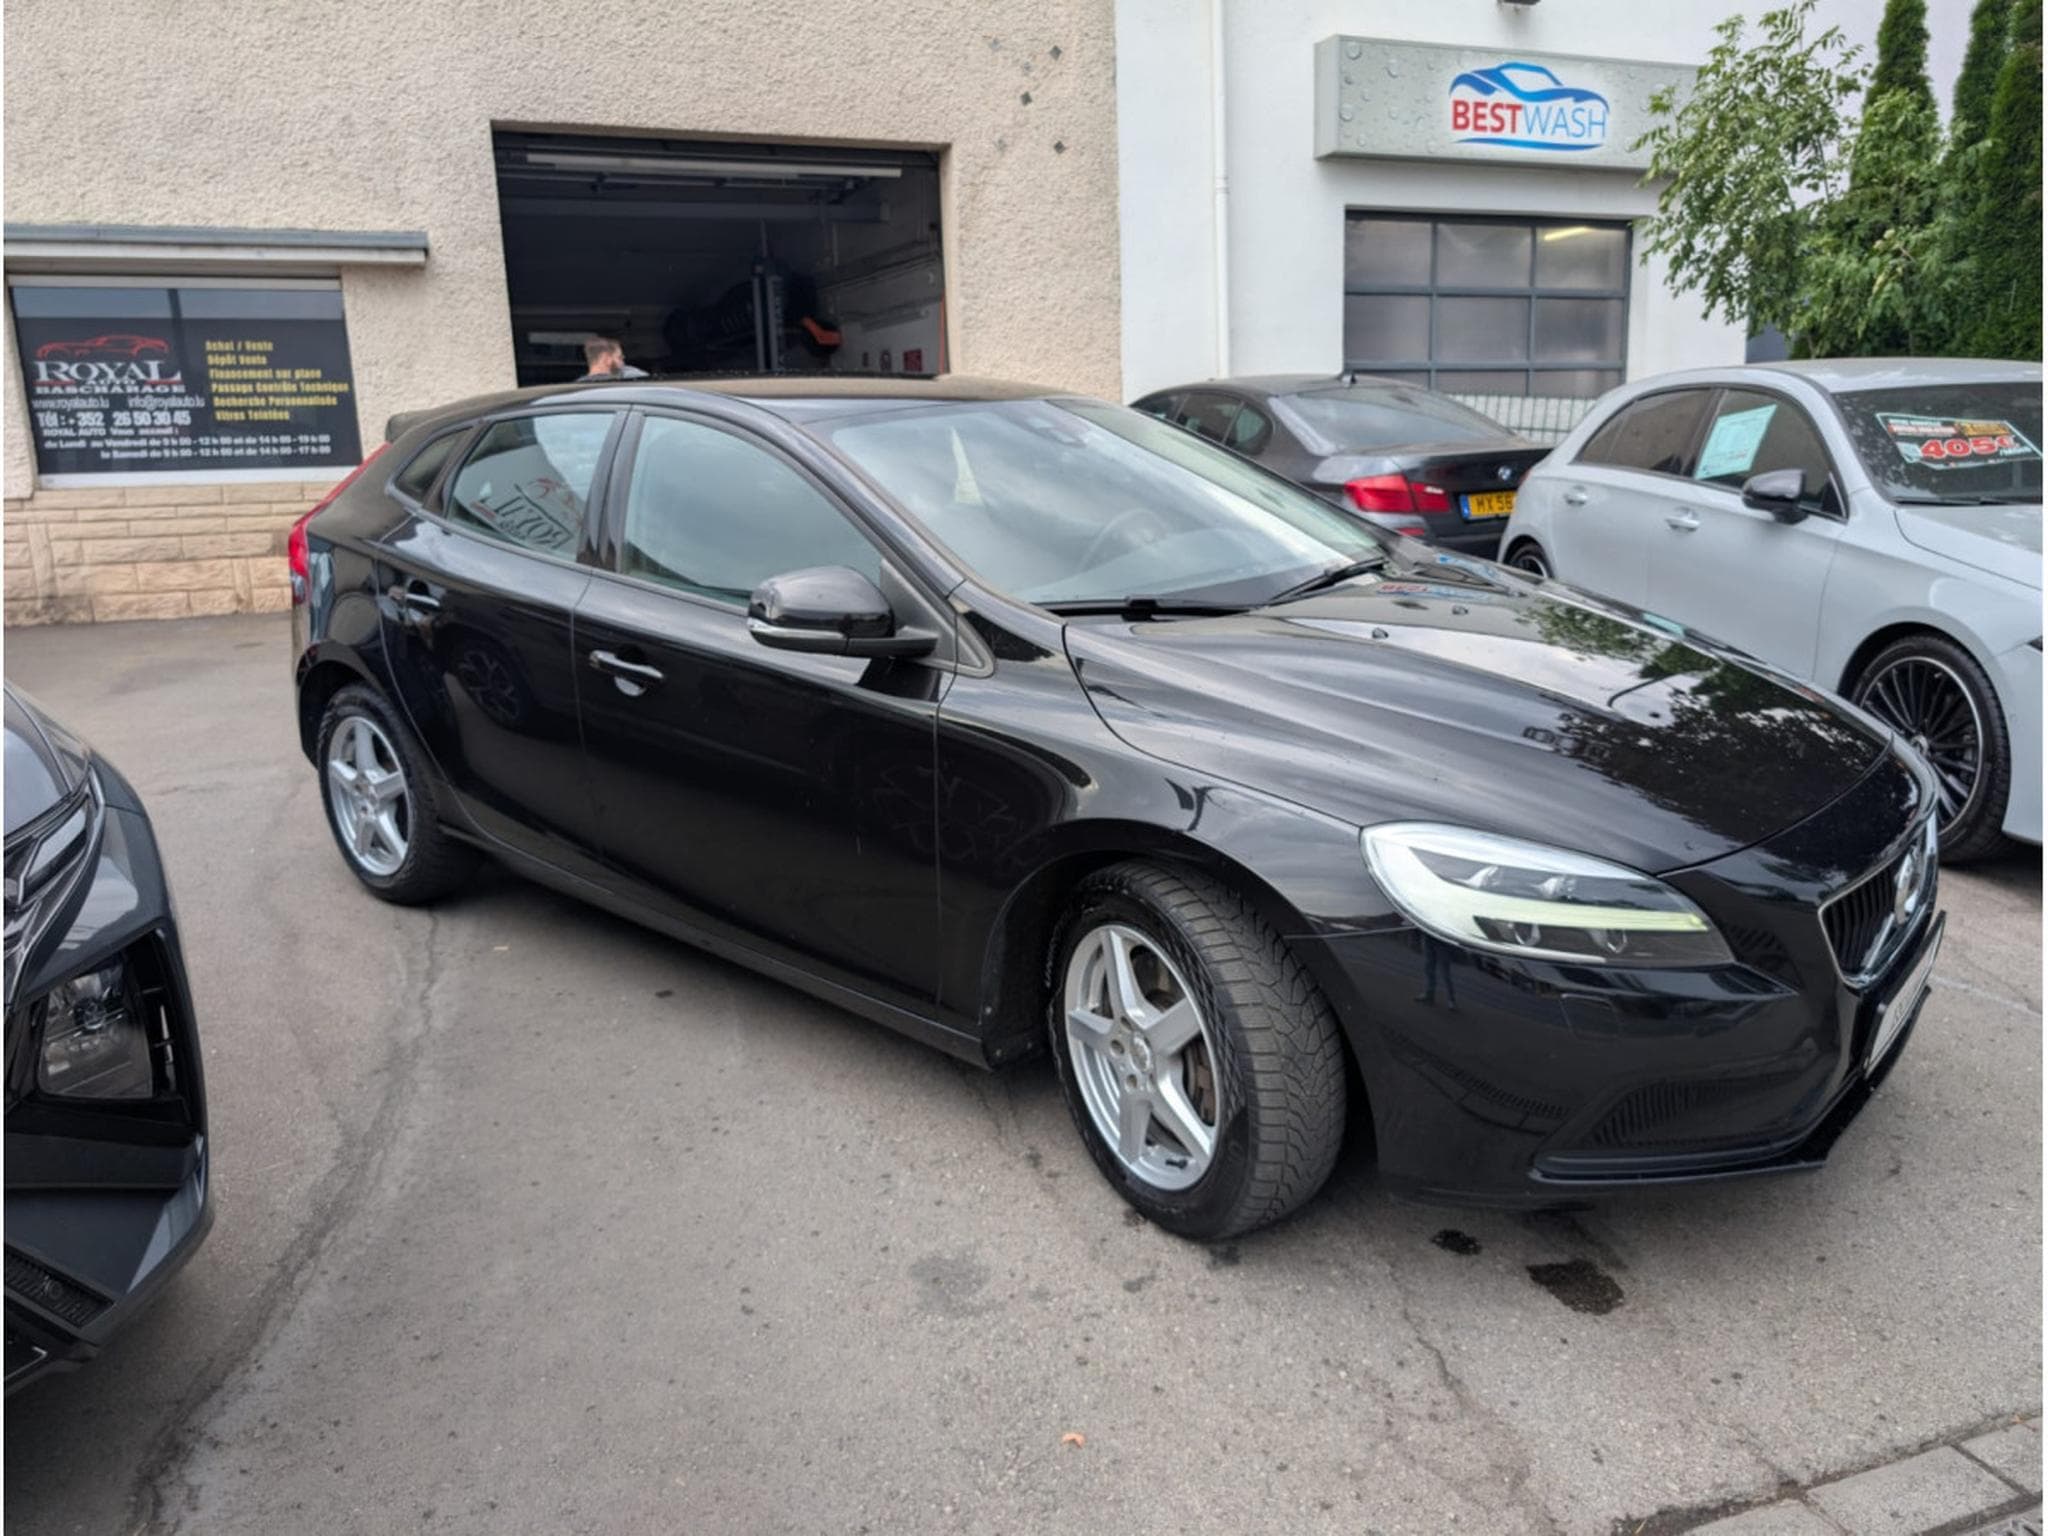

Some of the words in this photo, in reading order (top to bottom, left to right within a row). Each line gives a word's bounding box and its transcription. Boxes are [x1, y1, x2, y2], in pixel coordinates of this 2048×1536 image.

[245, 340, 273, 351] Vente
[239, 355, 267, 365] Vente
[34, 359, 182, 381] ROYAL
[209, 369, 273, 379] Financement
[275, 370, 291, 379] sur
[294, 368, 321, 379] place
[35, 384, 186, 394] BASCHARAGE
[211, 382, 253, 393] Passage
[300, 382, 349, 393] Technique
[213, 396, 266, 407] Recherche
[215, 410, 245, 420] Vitres
[43, 428, 76, 437] ROYAL
[78, 427, 106, 437] AUTO
[59, 439, 87, 448] Lundi
[104, 438, 147, 447] Vendredi
